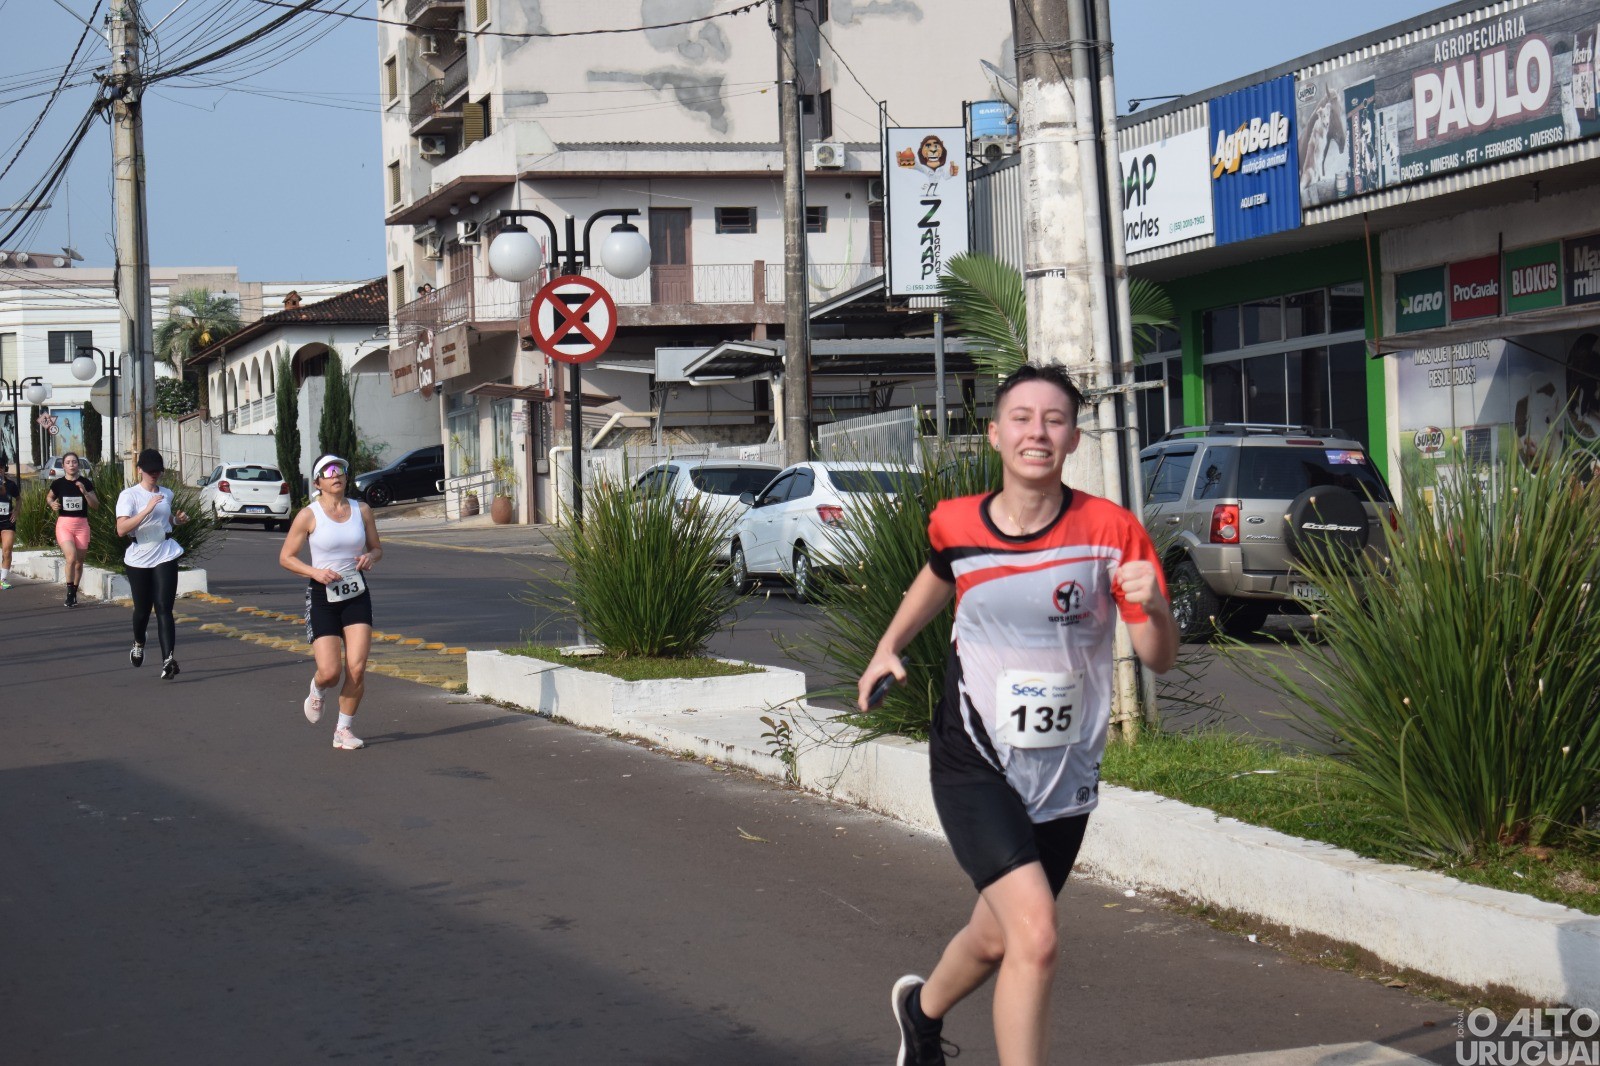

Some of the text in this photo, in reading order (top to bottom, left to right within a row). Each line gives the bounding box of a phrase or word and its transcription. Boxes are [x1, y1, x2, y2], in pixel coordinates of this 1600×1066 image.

[1434, 15, 1526, 63] AGROPECUÁRIA
[1414, 39, 1551, 141] PAULO
[1212, 111, 1288, 171] AgroBella
[1430, 153, 1459, 174] MINERAIS
[1466, 148, 1478, 164] PET
[1485, 137, 1523, 158] FERRAGENS
[1530, 126, 1563, 148] DIVERSOS
[1266, 150, 1287, 168] animal
[917, 199, 942, 280] ZAAP
[1574, 245, 1600, 272] Ma
[1453, 279, 1498, 302] ProCavalo
[1511, 263, 1557, 296] BLOKUS
[1402, 291, 1443, 315] AGRO
[1414, 348, 1431, 366] MAIS
[1433, 346, 1447, 364] QUE
[1428, 365, 1476, 389] RESULTADOS!
[332, 581, 359, 596] 183
[1011, 683, 1047, 698] Sesc
[1010, 703, 1073, 734] 135
